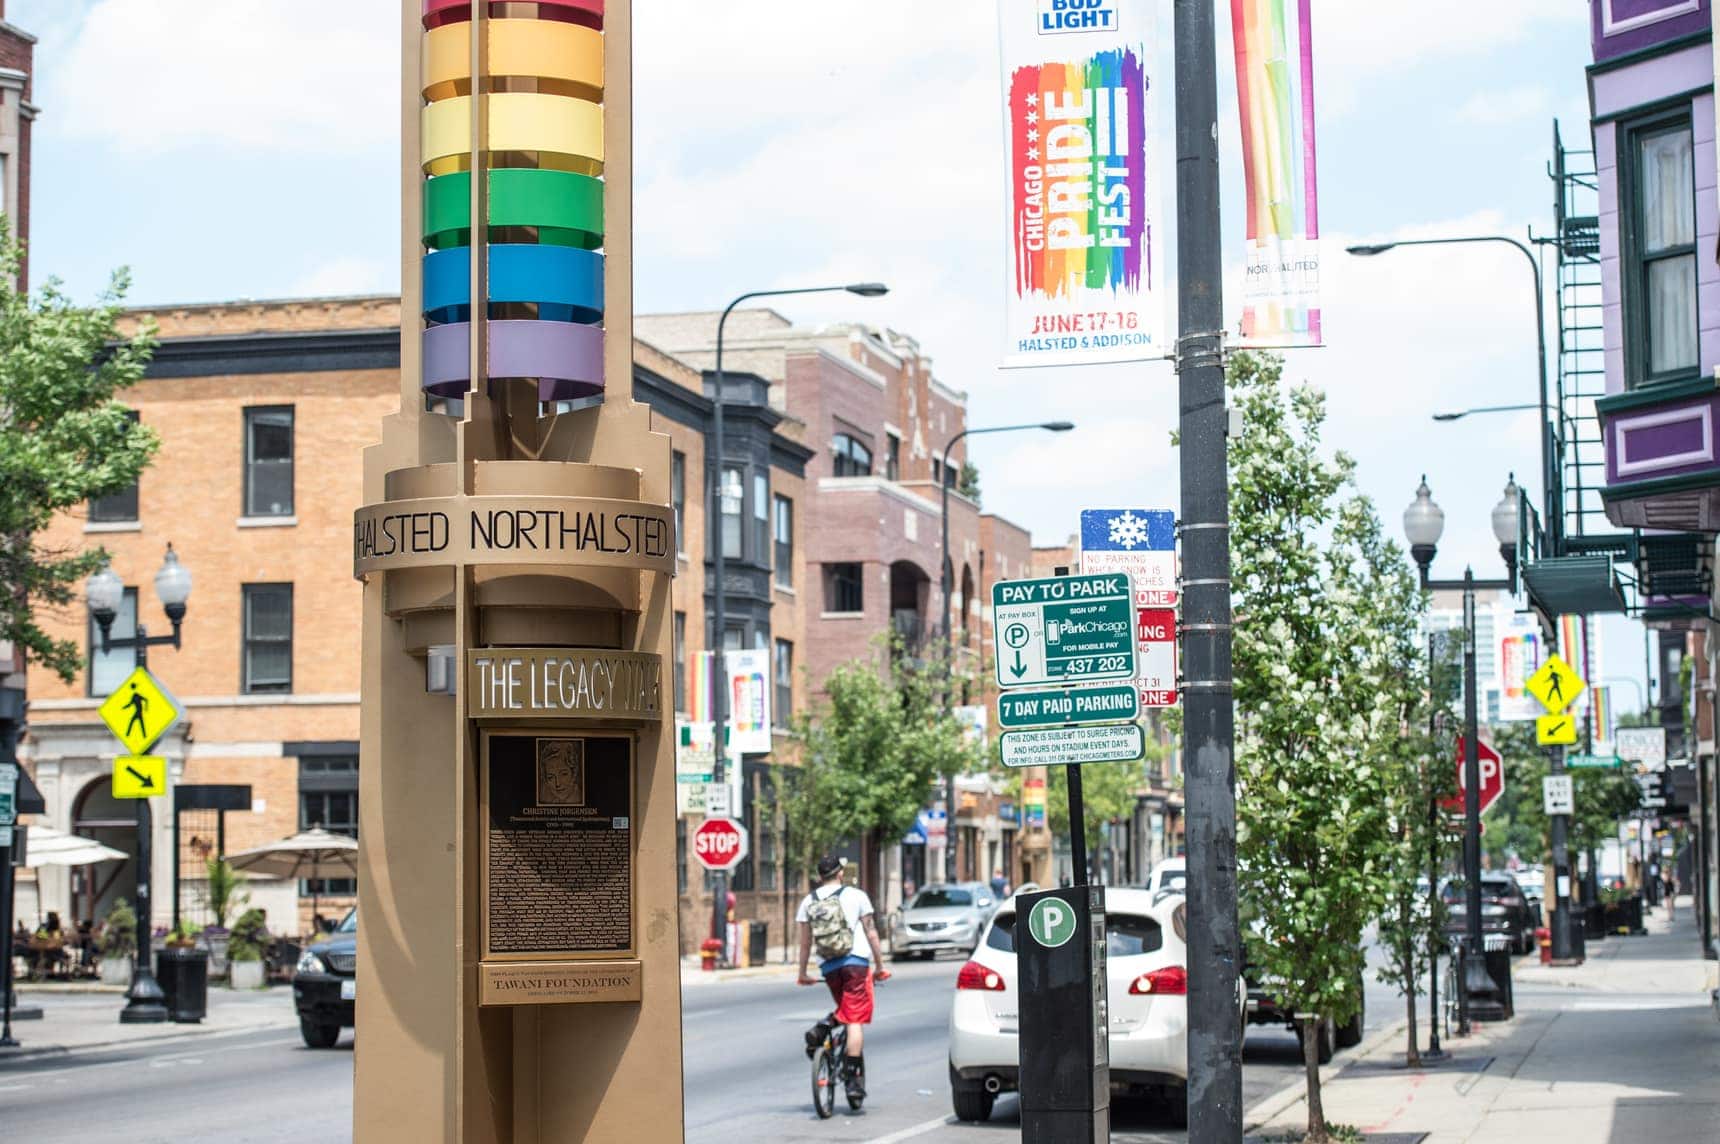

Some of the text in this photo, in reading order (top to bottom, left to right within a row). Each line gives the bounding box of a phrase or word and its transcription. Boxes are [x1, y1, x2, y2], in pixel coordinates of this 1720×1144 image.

[1052, 0, 1102, 10] BUD
[1042, 10, 1112, 30] LIGHT
[1044, 88, 1095, 250] PRIDE
[1024, 165, 1044, 252] CHICAGO
[1097, 161, 1131, 248] FEST
[1032, 312, 1138, 334] JUNE 17-18
[1018, 333, 1152, 352] HALSTED & ADDISON
[470, 510, 668, 557] NORTHALSTED
[1088, 554, 1146, 563] NO PARKING
[1135, 576, 1164, 585] NCHES
[1002, 578, 1119, 602] PAY TO PARK
[1136, 592, 1169, 604] ONE
[1060, 620, 1128, 634] ParkChicago
[1140, 626, 1165, 638] ING
[1012, 628, 1024, 644] P
[1067, 657, 1126, 674] 437 202
[476, 657, 522, 710] THE
[530, 656, 620, 711] LEGACY
[1003, 694, 1132, 717] 7 DAY PAID PARKING
[1140, 691, 1169, 704] ONE
[1008, 734, 1021, 742] THIS
[1022, 733, 1040, 741] ZONE
[1086, 729, 1108, 738] SURGE
[1110, 727, 1135, 736] PRICING
[1014, 746, 1027, 754] AND
[1028, 744, 1050, 753] HOURS
[1051, 744, 1060, 752] ON
[1062, 742, 1088, 752] STADIUM
[1090, 741, 1110, 750] EVENT
[1034, 756, 1048, 764] CALL
[696, 832, 739, 854] STOP
[1044, 906, 1063, 939] P
[494, 976, 630, 990] TAWANI FOUNDATION
